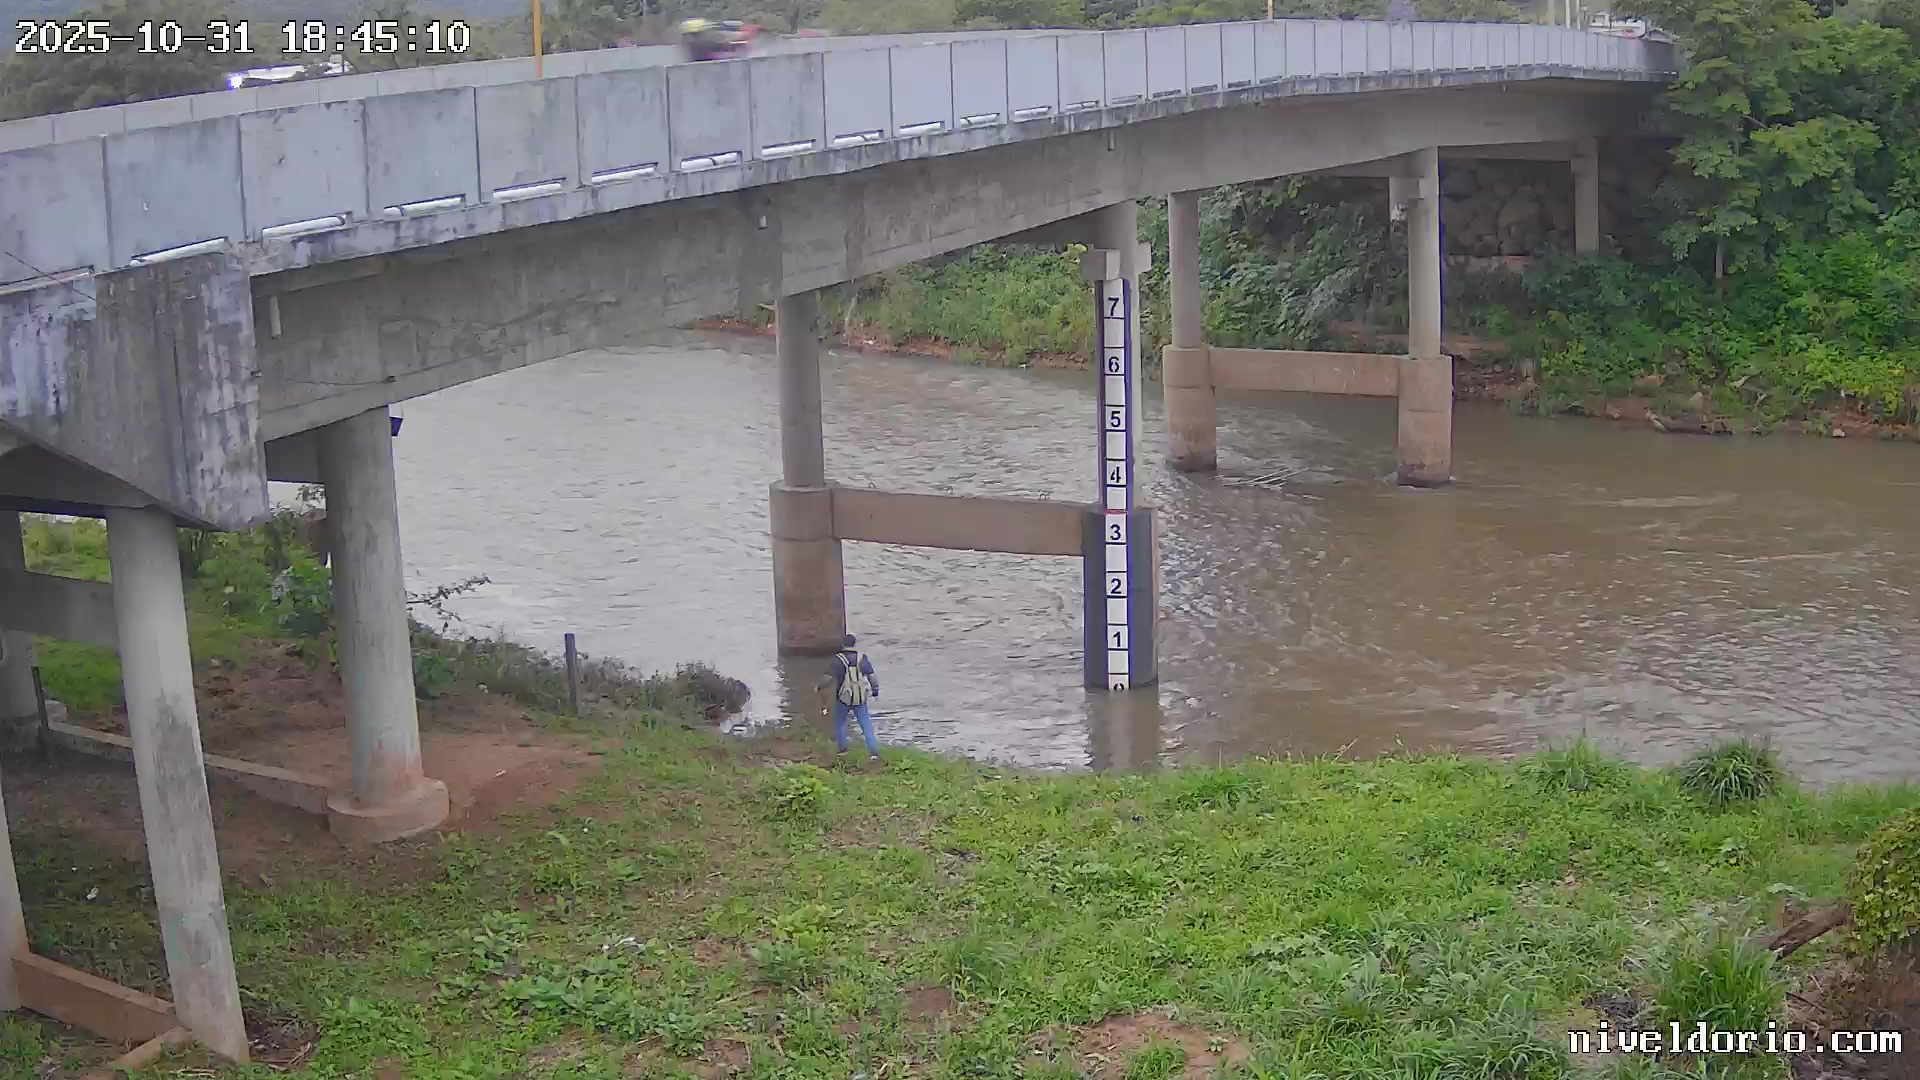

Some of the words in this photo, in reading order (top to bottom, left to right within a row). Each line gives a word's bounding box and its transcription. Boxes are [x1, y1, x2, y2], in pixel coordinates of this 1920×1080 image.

[1108, 297, 1119, 316] 7
[1108, 356, 1120, 373] 6
[1110, 411, 1121, 428] 5
[1110, 466, 1121, 483] 4
[1110, 524, 1121, 540] 3
[1110, 578, 1122, 594] 2
[1113, 631, 1121, 647] 1
